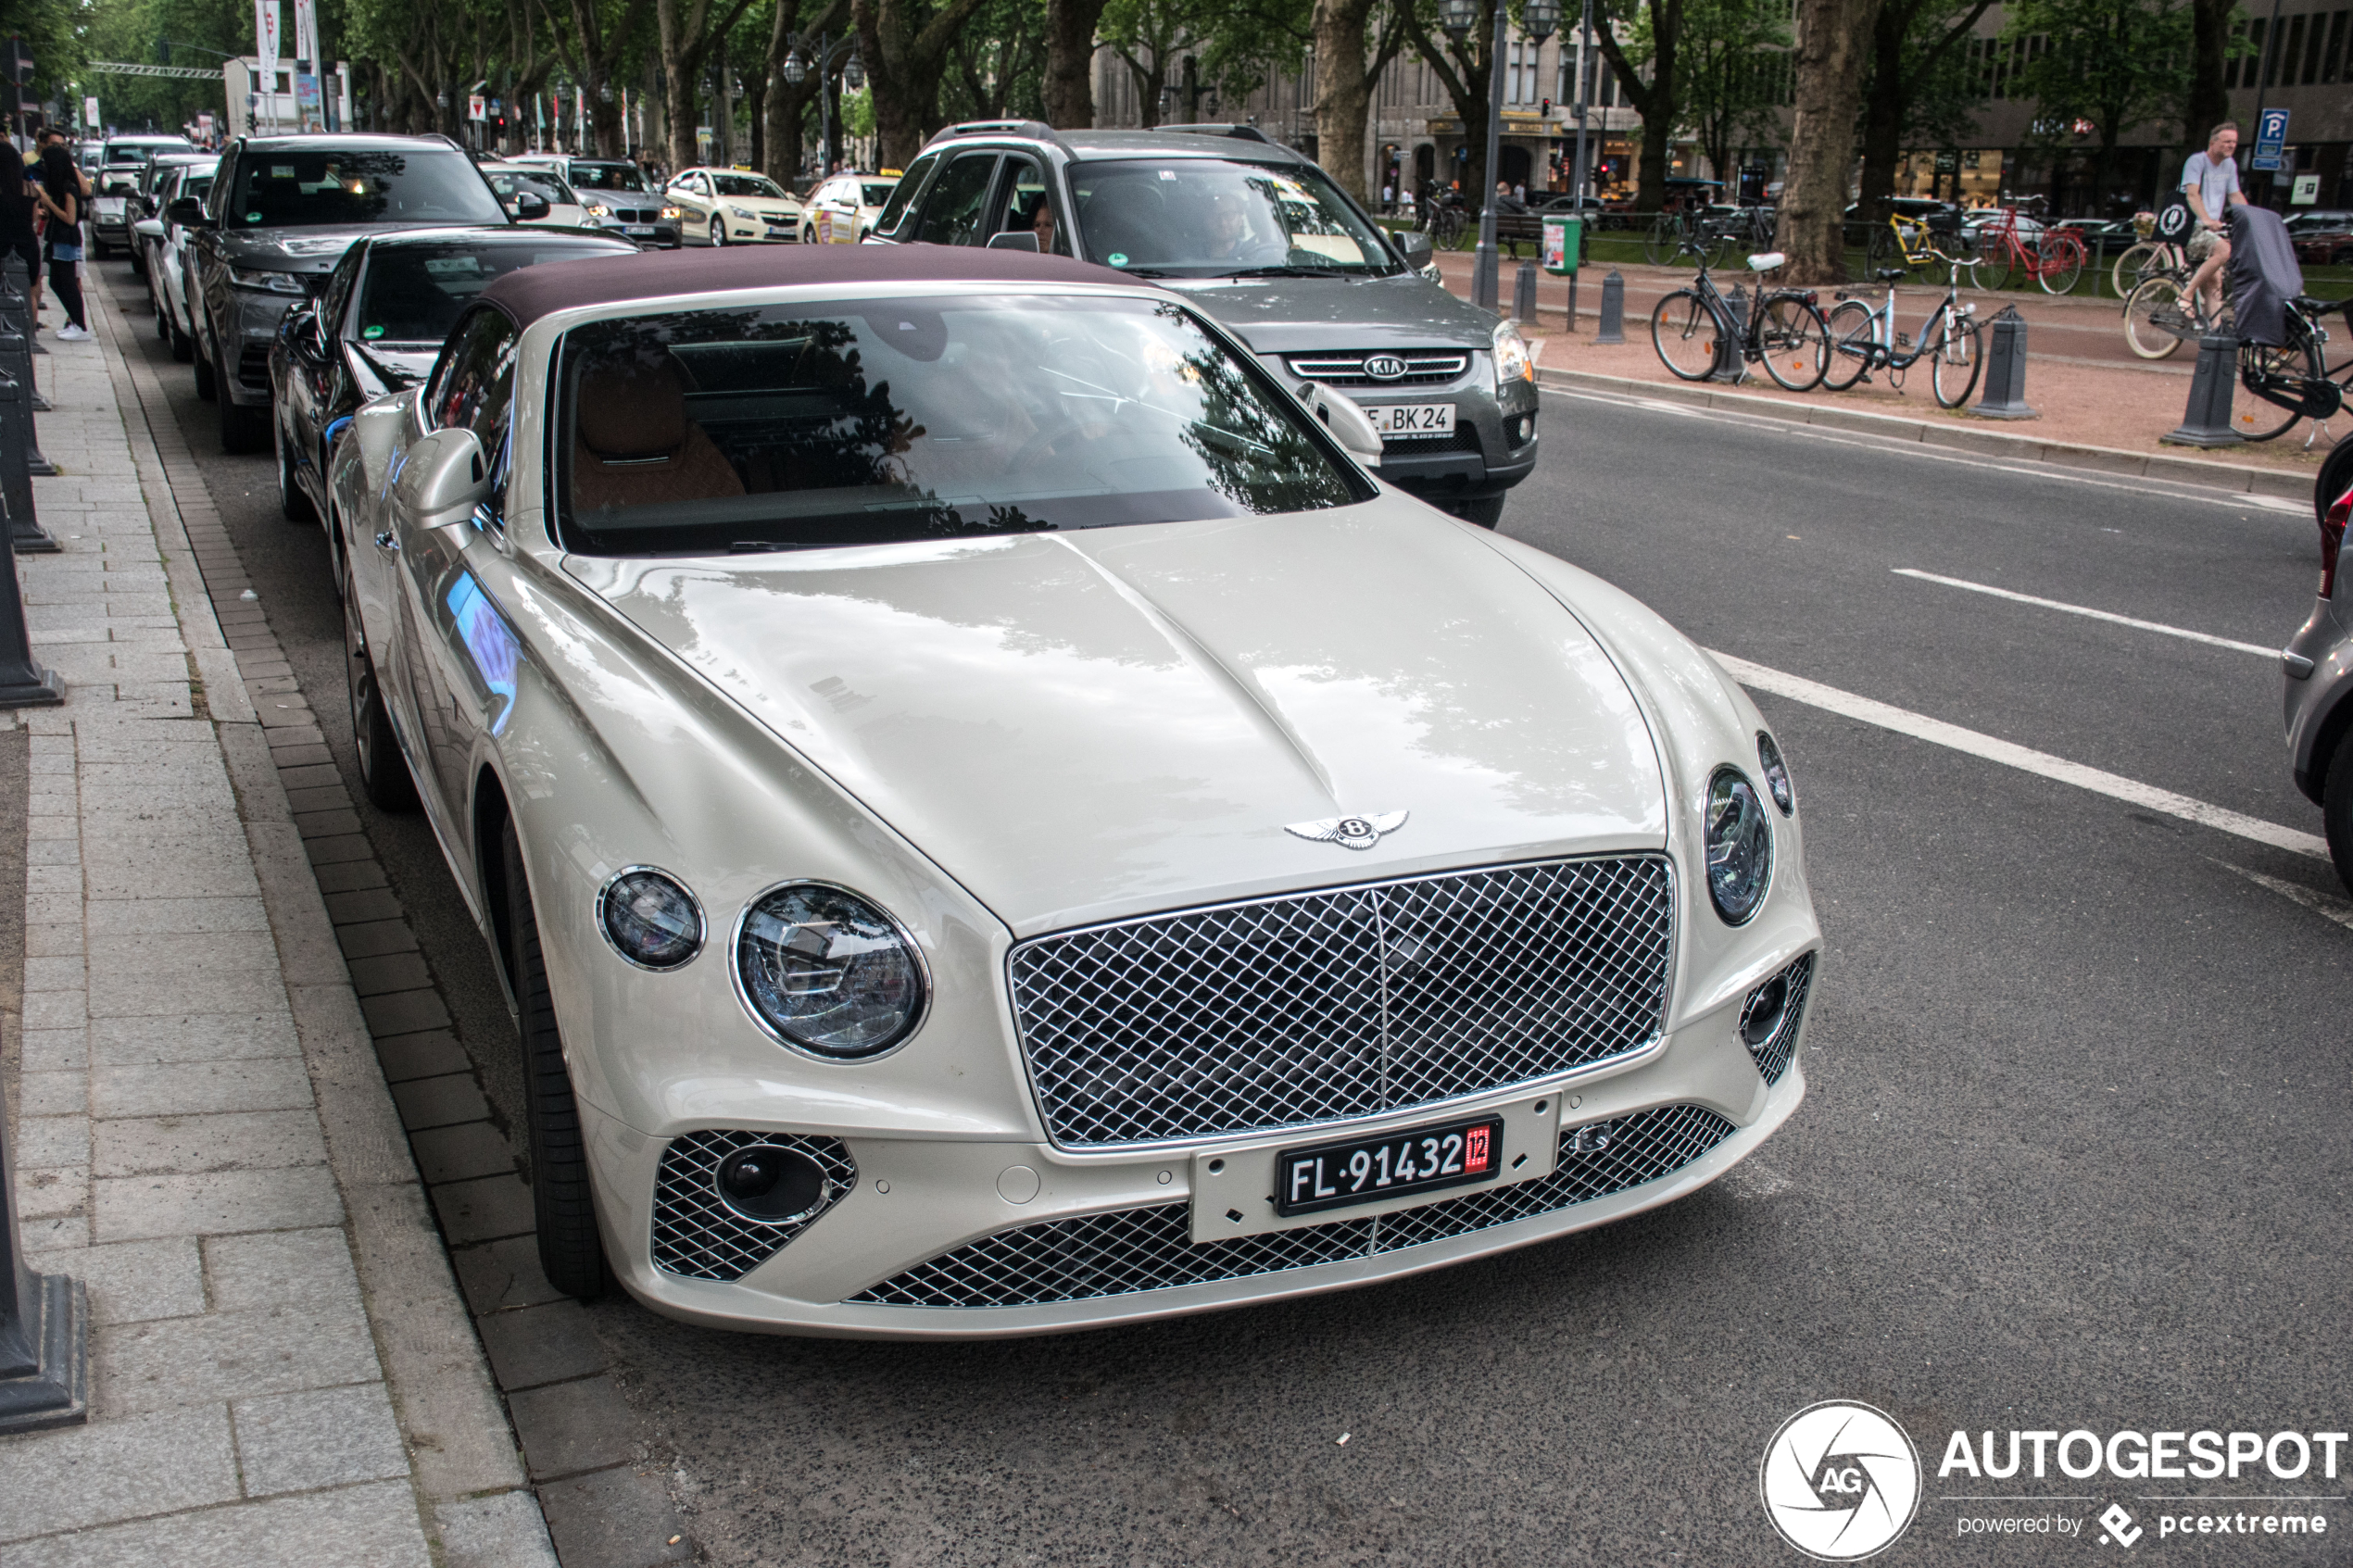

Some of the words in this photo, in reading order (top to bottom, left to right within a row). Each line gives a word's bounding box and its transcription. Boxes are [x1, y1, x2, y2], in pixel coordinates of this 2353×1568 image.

[2267, 119, 2282, 137] P
[1372, 360, 1402, 374] KIA
[1364, 409, 1379, 431] E
[1393, 408, 1418, 430] BK
[1423, 408, 1446, 429] 24
[1344, 820, 1366, 835] B
[1469, 1135, 1486, 1160] 12
